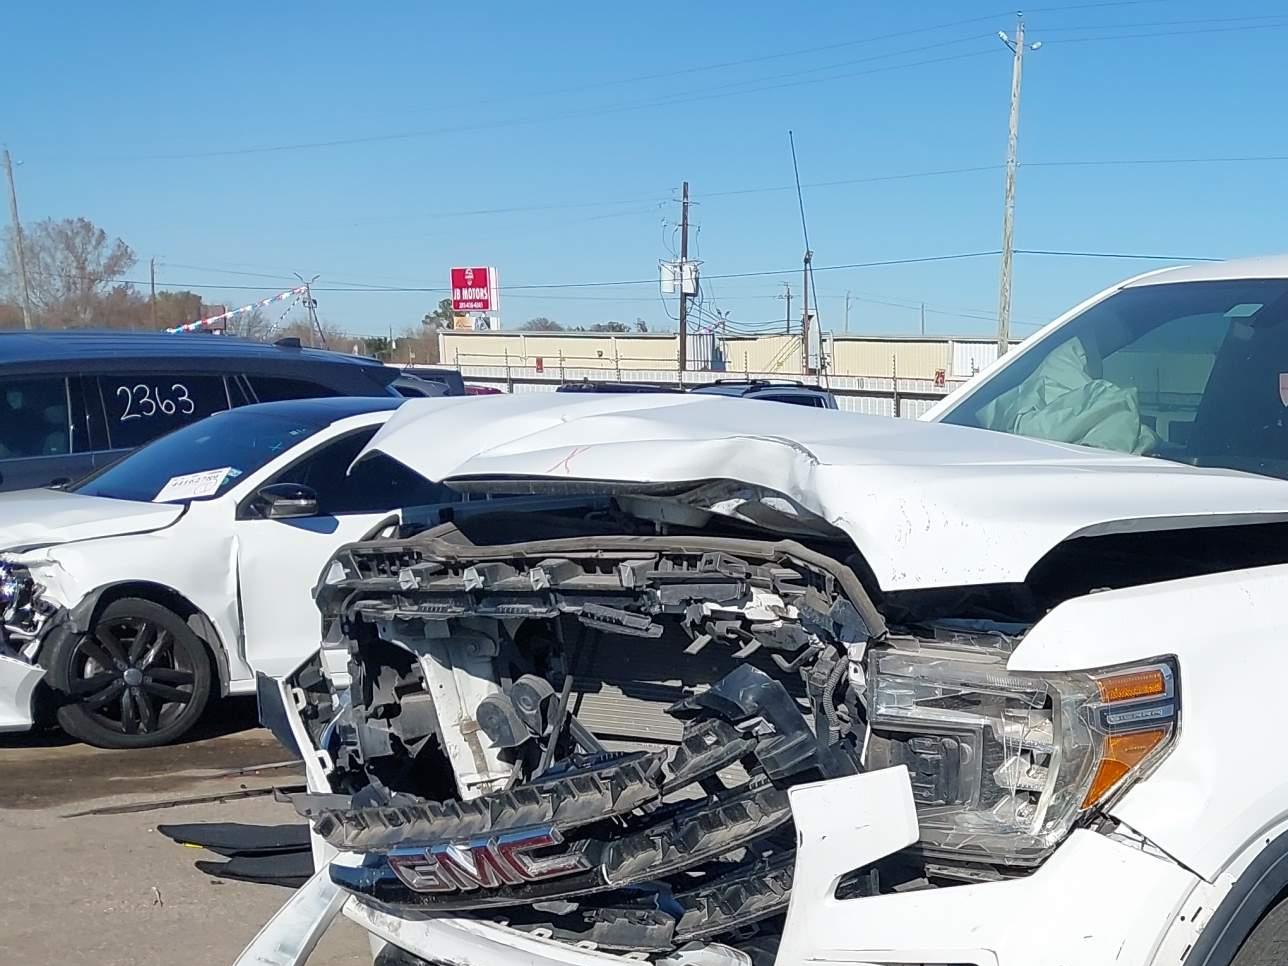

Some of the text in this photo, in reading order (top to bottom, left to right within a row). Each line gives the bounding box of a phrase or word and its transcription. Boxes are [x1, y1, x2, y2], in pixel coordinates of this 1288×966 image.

[453, 287, 488, 301] JB MOTORS
[116, 384, 195, 420] 2363
[387, 825, 593, 893] GMC
